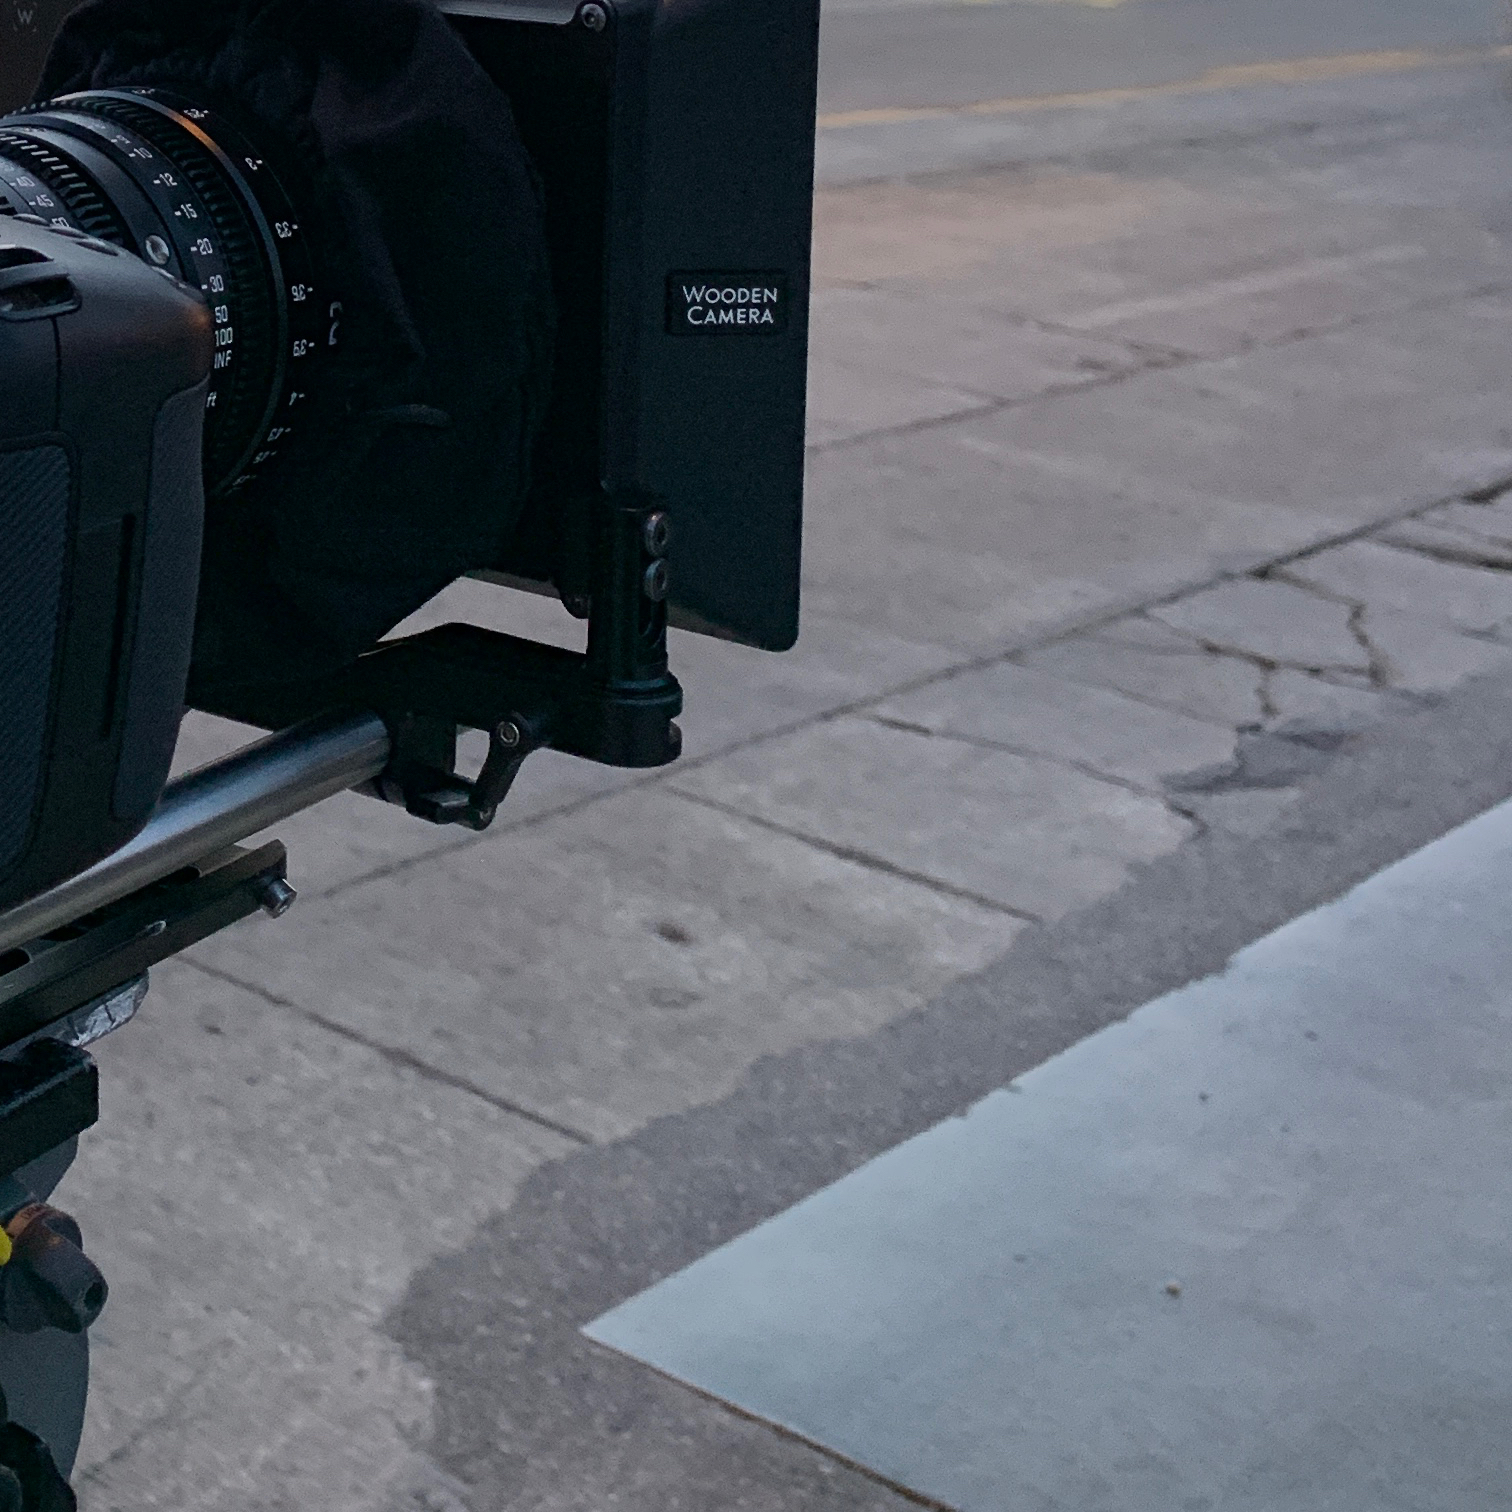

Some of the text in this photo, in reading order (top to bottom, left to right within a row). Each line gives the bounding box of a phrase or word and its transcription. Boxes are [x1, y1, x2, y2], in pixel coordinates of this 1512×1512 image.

[209, 274, 224, 293] 30
[682, 285, 778, 304] WOODEN
[215, 305, 228, 323] 50
[687, 306, 774, 325] CAMERA
[215, 327, 233, 347] 100
[214, 349, 233, 369] INF
